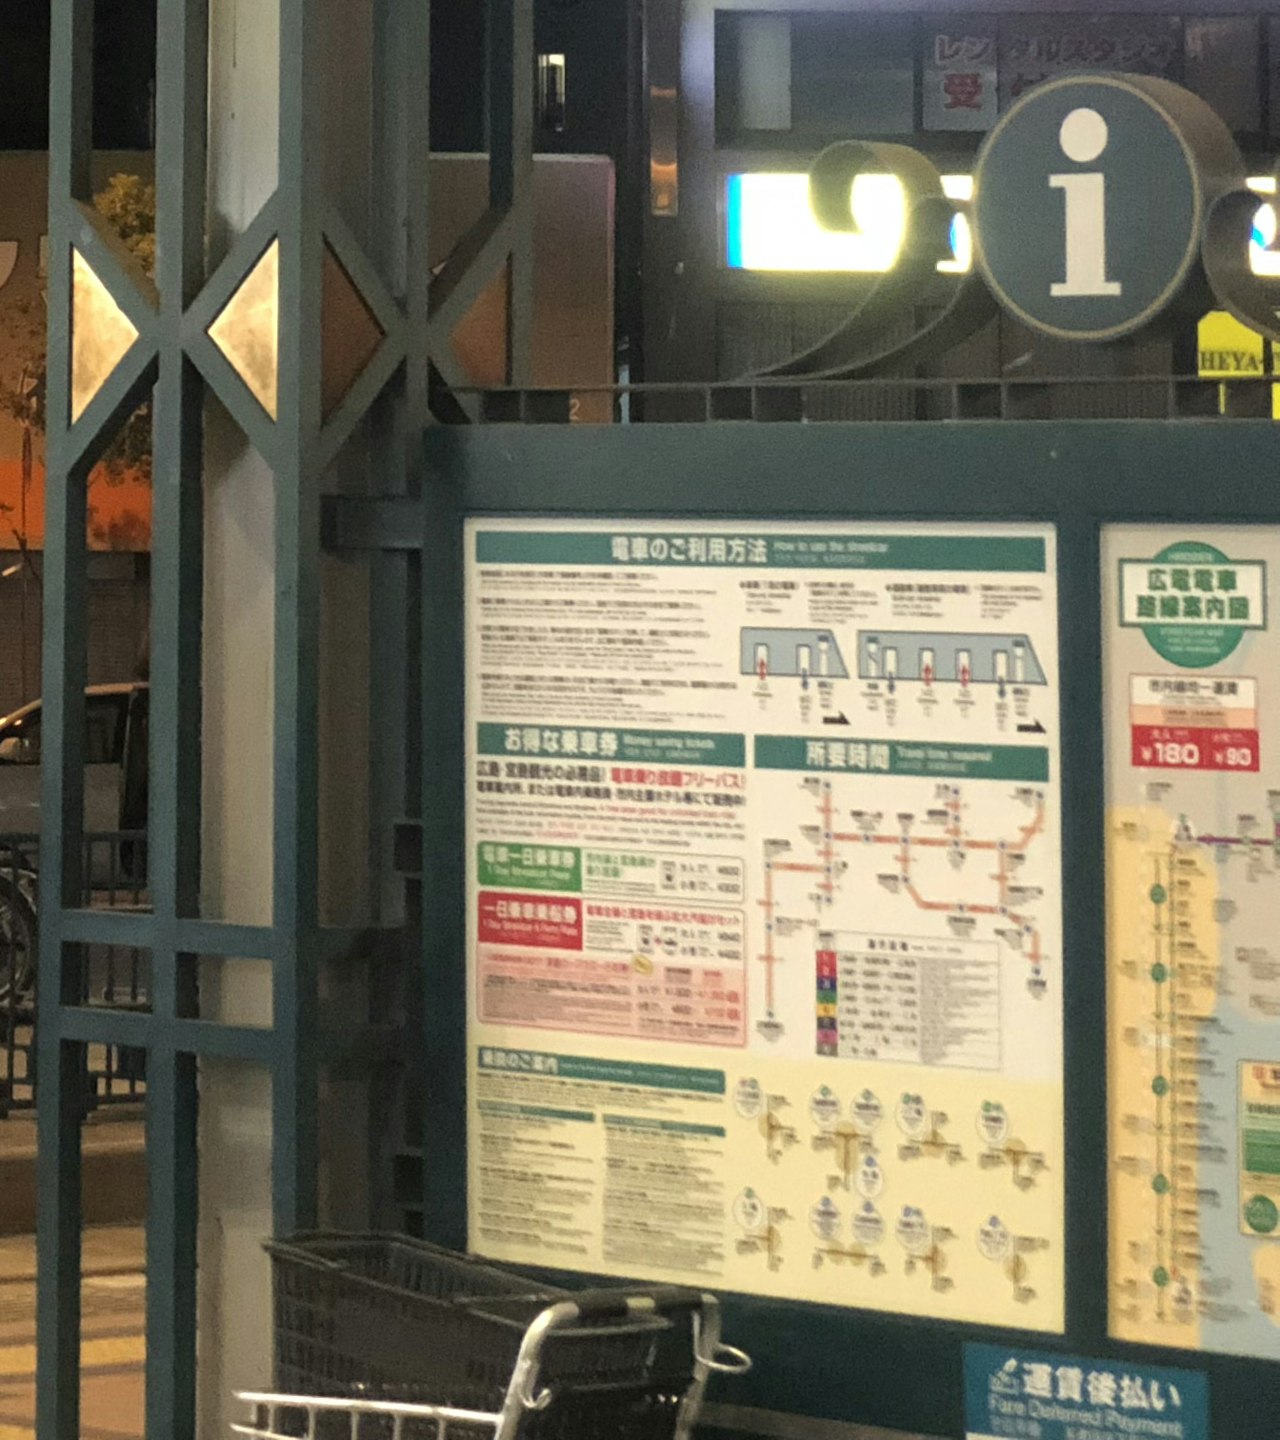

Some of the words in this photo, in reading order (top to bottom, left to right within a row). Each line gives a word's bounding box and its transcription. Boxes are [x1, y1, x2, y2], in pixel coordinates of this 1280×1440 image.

[611, 536, 768, 563] 電車のご利用方法
[504, 727, 619, 757] お得な乗車券
[1022, 1362, 1181, 1412] 運賃後払い
[989, 1393, 1028, 1417] Fare
